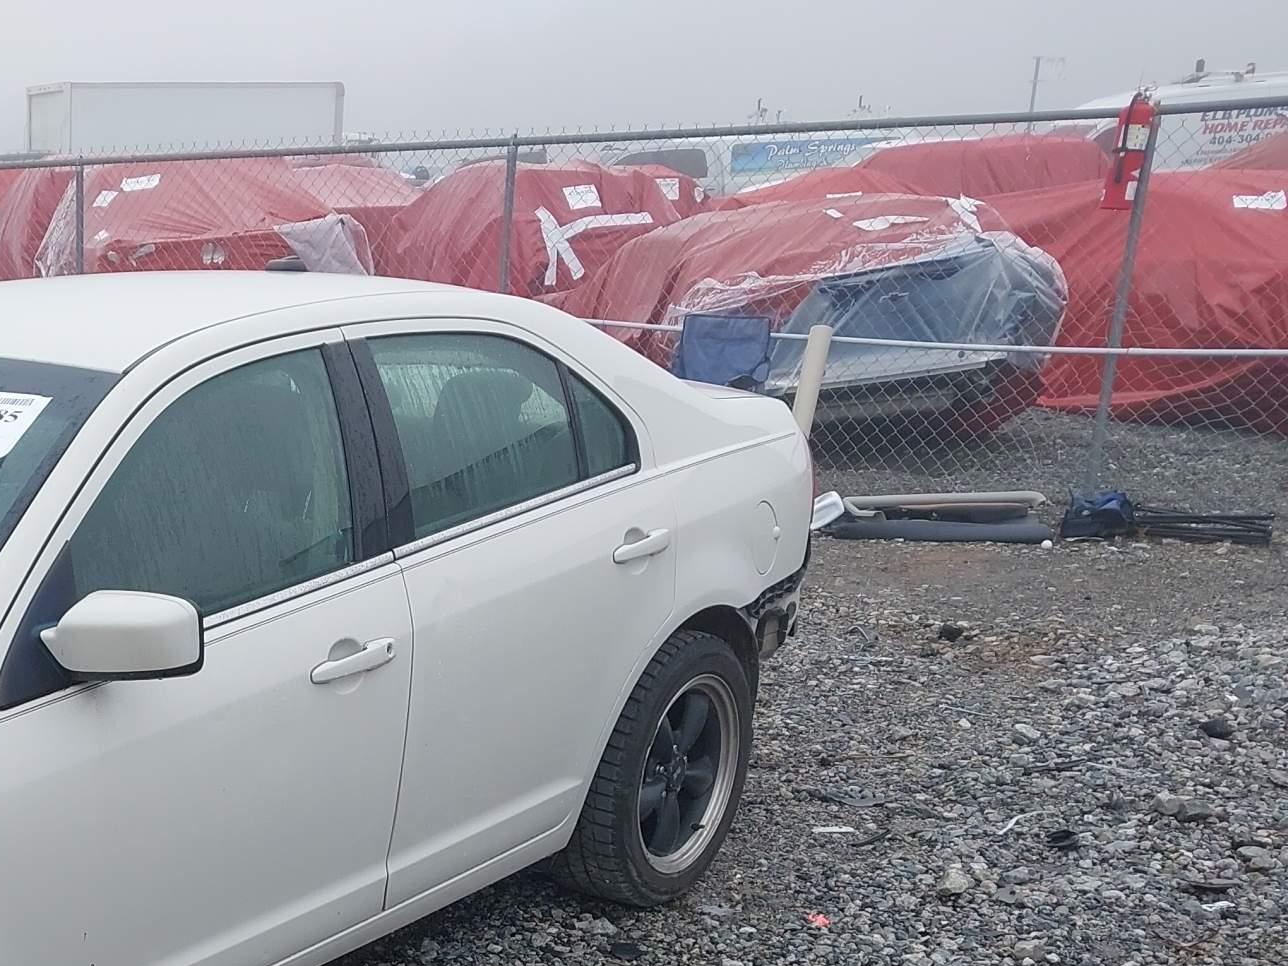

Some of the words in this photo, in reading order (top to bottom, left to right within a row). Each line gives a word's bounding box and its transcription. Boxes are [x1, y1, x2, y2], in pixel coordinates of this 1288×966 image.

[1202, 121, 1250, 134] HOME
[765, 145, 800, 160] Palm
[804, 141, 858, 157] Springs
